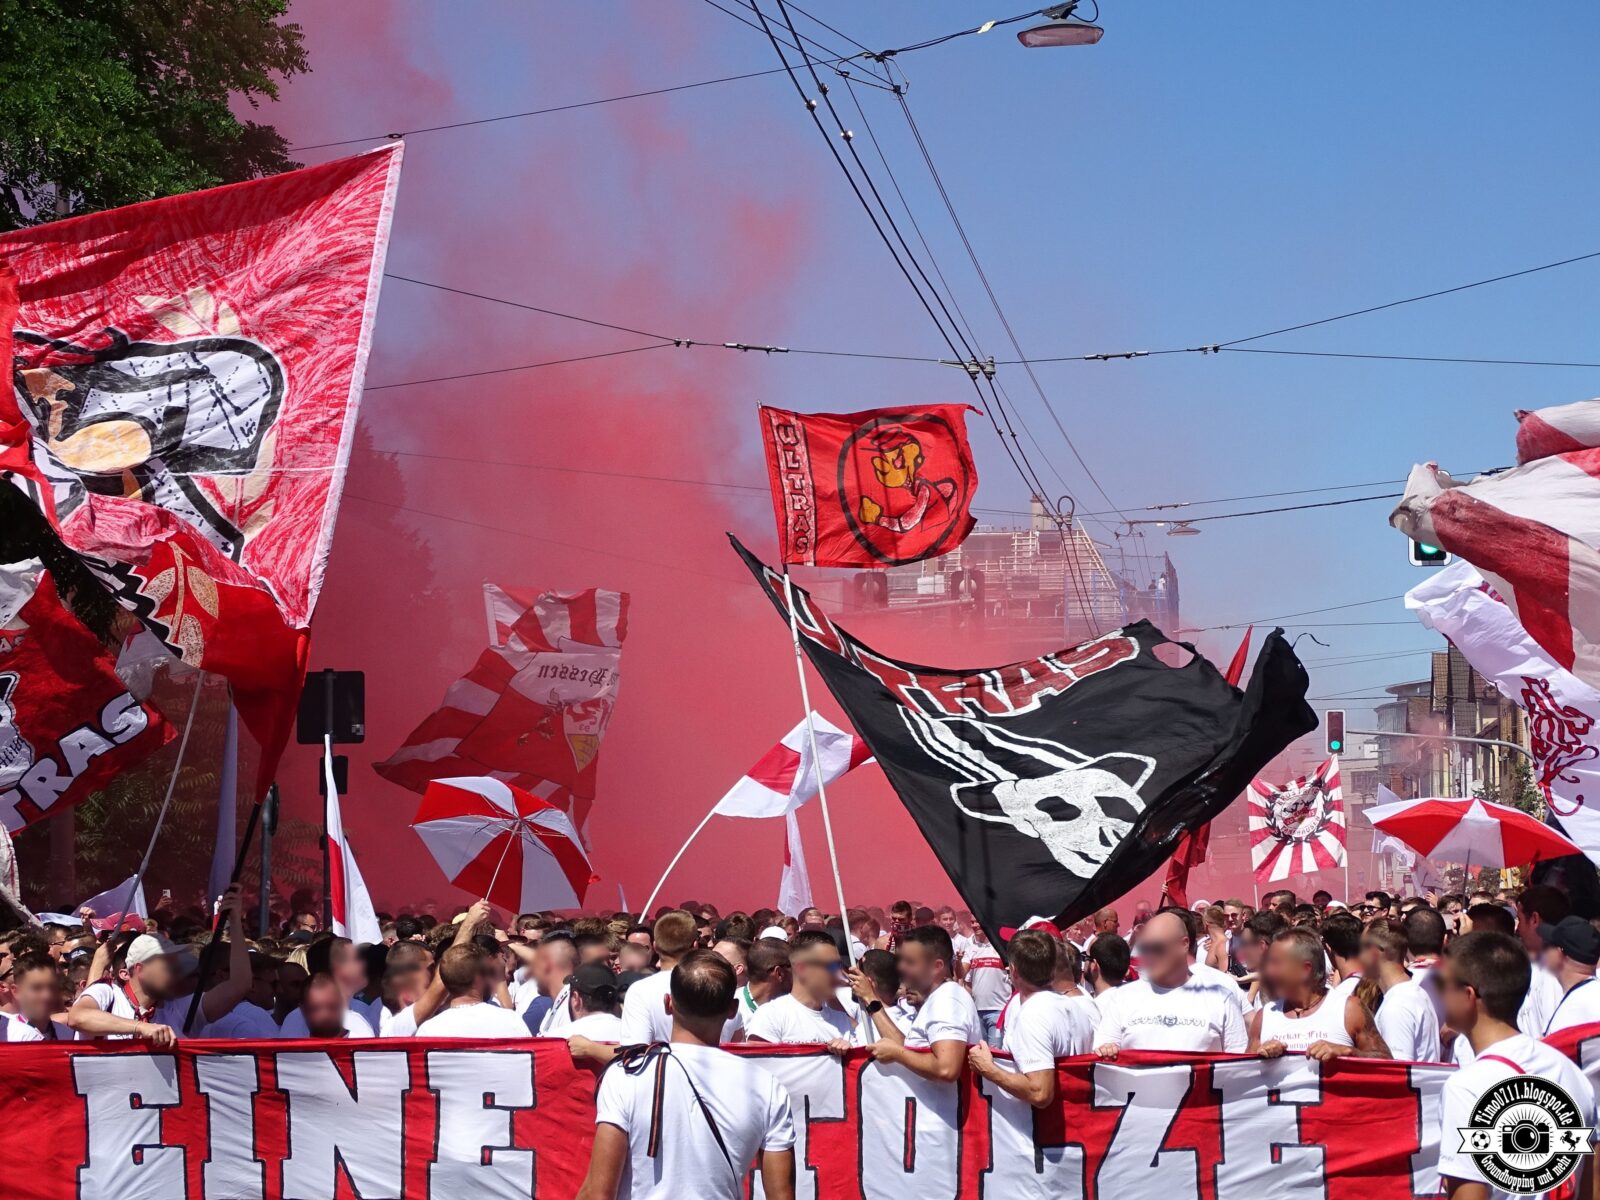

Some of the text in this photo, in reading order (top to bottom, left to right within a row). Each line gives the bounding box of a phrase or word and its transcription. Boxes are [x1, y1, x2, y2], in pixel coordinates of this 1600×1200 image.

[776, 424, 810, 554] ULTRAS
[762, 565, 1141, 719] UTRAS
[70, 1050, 537, 1200] EINE
[737, 1051, 1328, 1200] TOLZE
